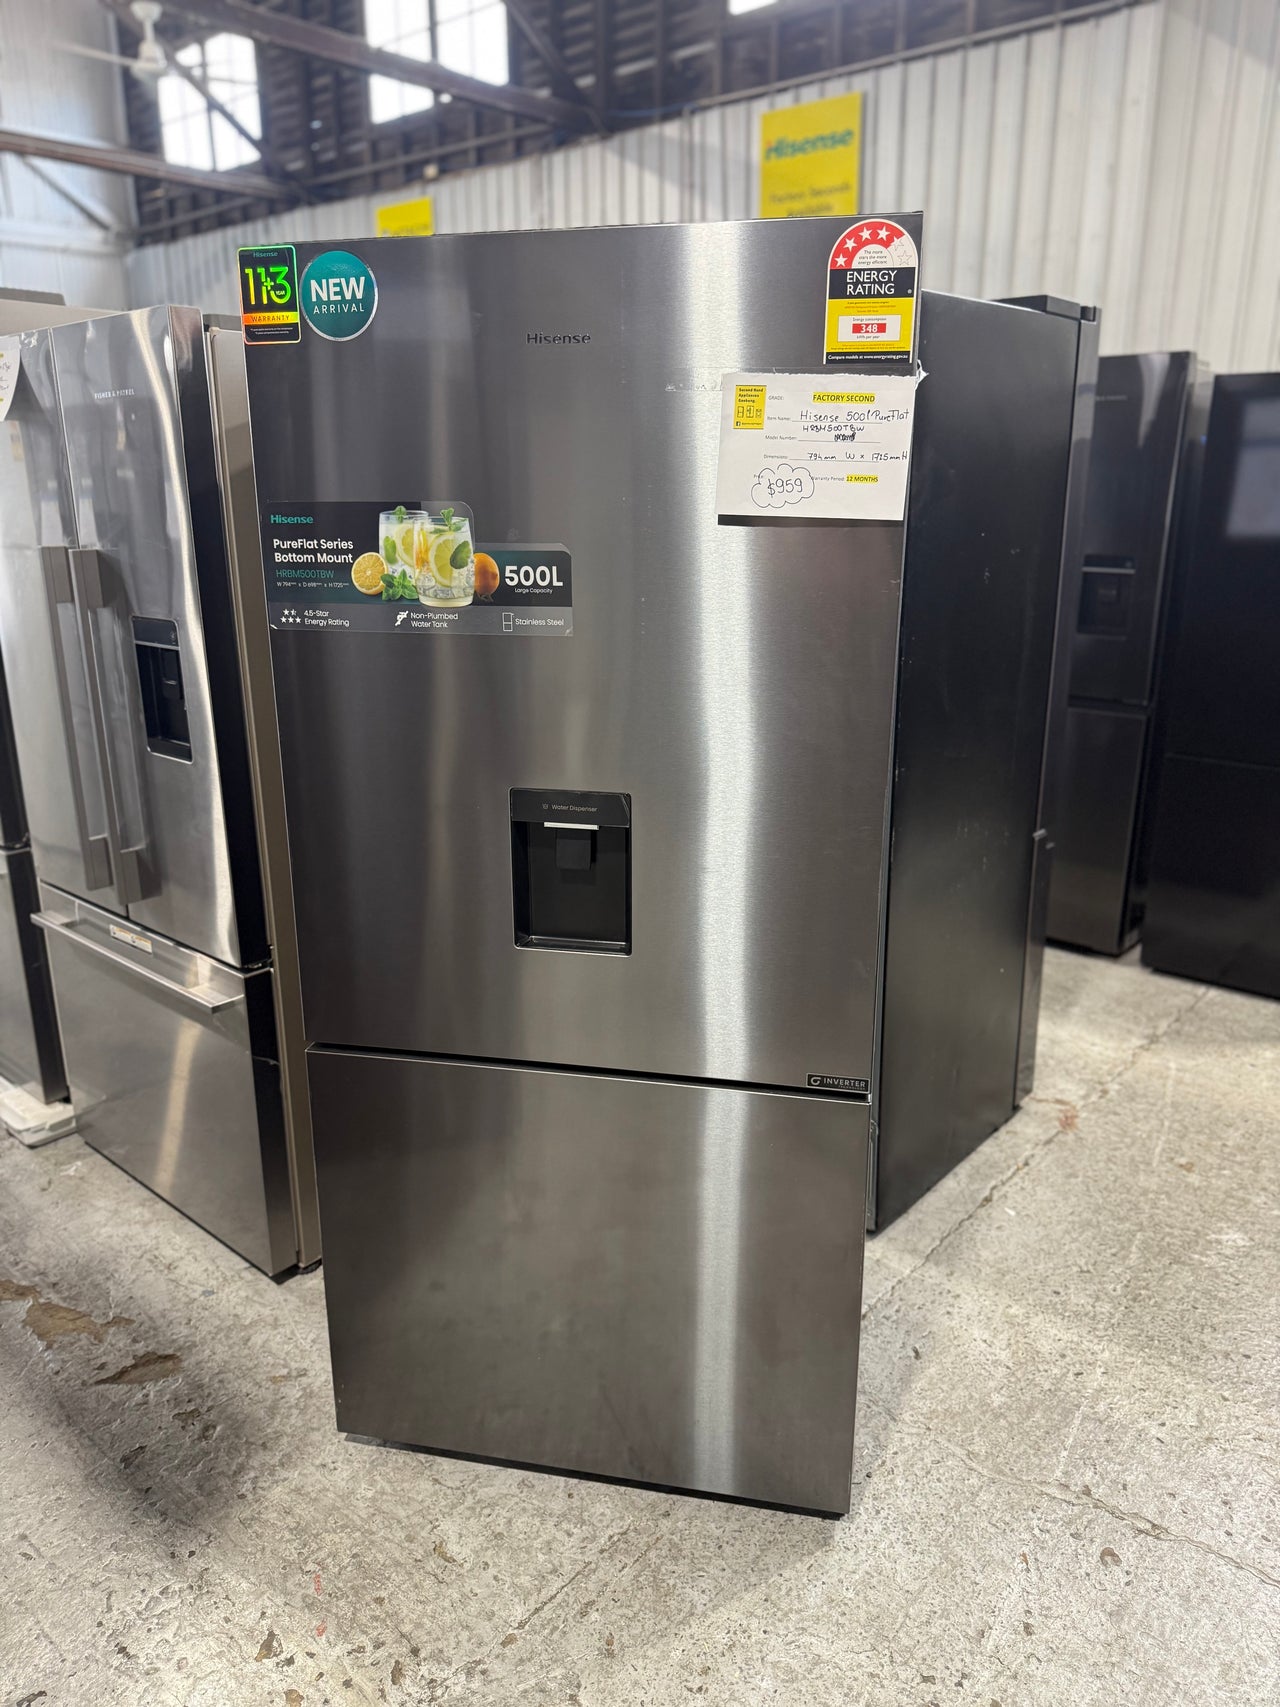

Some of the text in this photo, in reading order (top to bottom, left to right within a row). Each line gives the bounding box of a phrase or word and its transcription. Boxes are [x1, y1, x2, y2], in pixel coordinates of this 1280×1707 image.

[765, 129, 854, 160] Hisense
[846, 270, 897, 283] ENERGY
[310, 277, 366, 302] NEW
[846, 283, 895, 296] RATING
[313, 303, 365, 315] ARRIVAL
[250, 314, 290, 323] WARRANTY
[860, 324, 878, 333] 348
[526, 332, 591, 344] Hisense
[813, 394, 844, 402] FACTORY
[800, 409, 839, 421] Hisense
[767, 477, 803, 499] $959
[270, 514, 314, 524] Hisense
[273, 538, 354, 550] PureFlat Series
[274, 553, 354, 564] Bottom Mount
[276, 569, 334, 579] HRBM500TBW
[504, 565, 564, 587] 500L
[410, 612, 459, 620] Non-Plumbed
[304, 618, 350, 627] Energy Rating
[432, 620, 449, 628] Tank
[515, 618, 546, 626] Stainless
[823, 1077, 866, 1087] INVERTER
